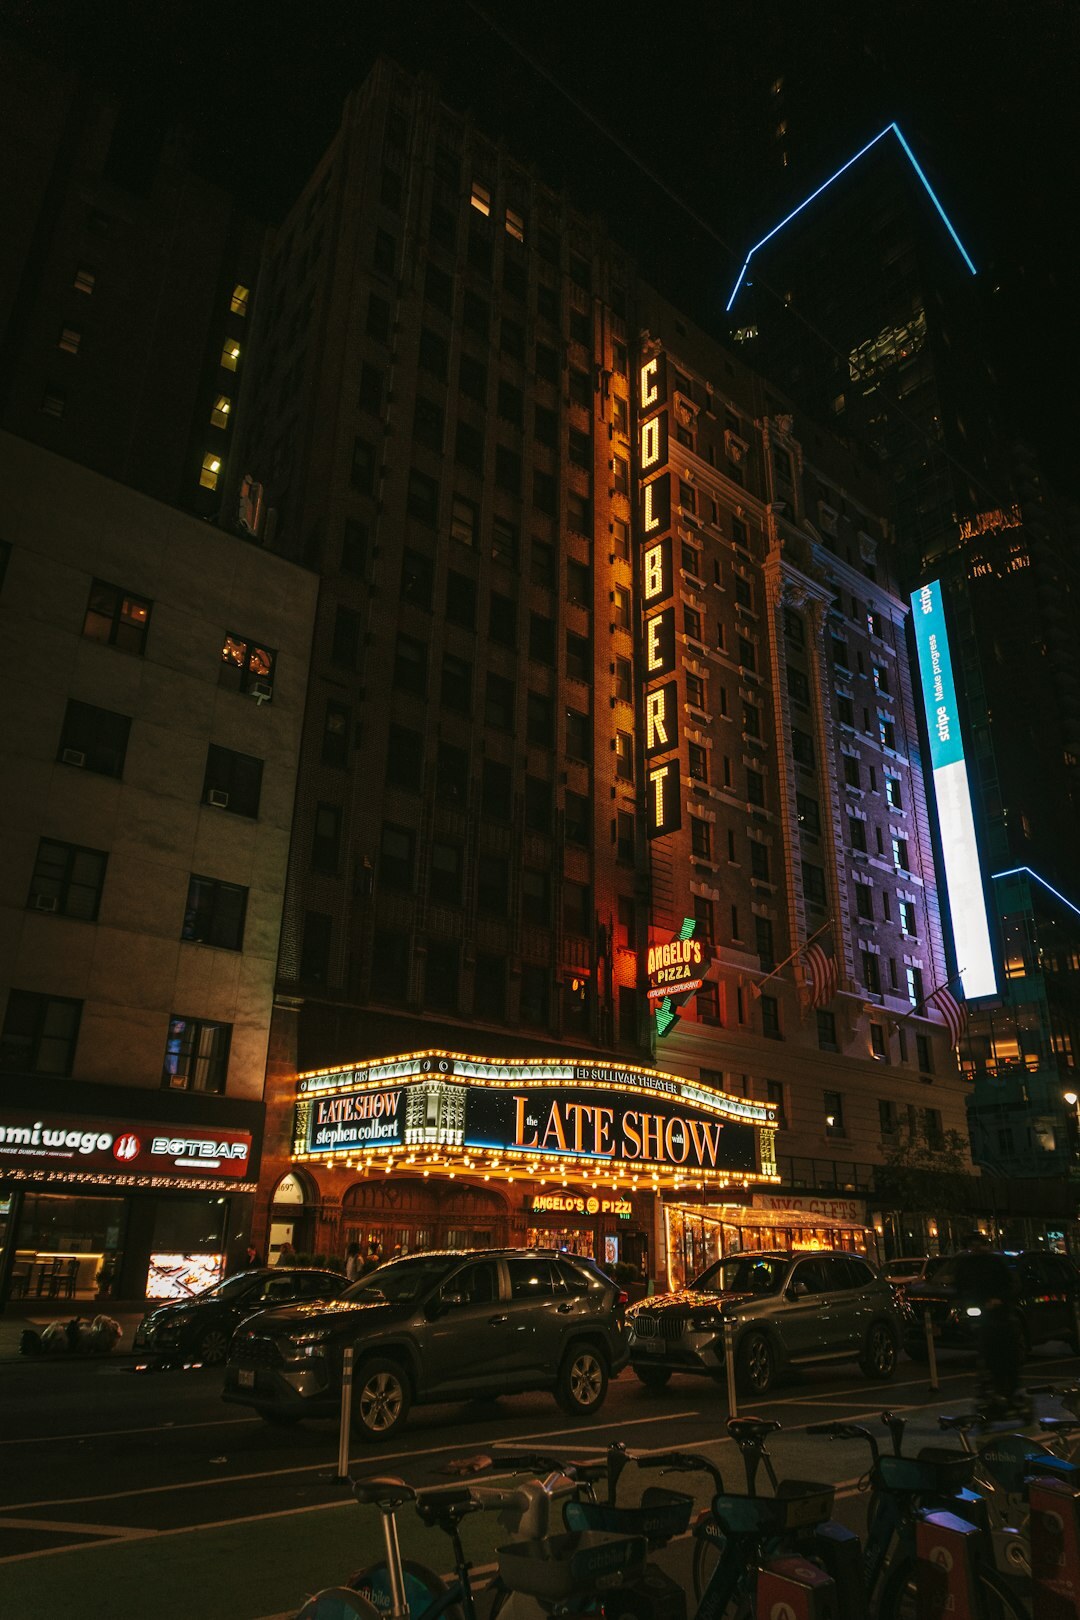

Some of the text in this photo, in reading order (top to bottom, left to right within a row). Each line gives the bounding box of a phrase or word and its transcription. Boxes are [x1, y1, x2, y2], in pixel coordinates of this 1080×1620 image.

[641, 358, 669, 828] COLBERT
[929, 634, 950, 742] stripe Make progress
[647, 939, 702, 975] ANGELO'S
[657, 964, 692, 983] PIZZA
[354, 1070, 369, 1083] CBS
[576, 1067, 678, 1094] ED SULLIVAN THEATER
[317, 1091, 402, 1125] LATE SHOW
[512, 1095, 724, 1167] LATE SHOW
[526, 1115, 538, 1127] the
[316, 1118, 399, 1151] stephen colbert
[671, 1134, 684, 1144] with
[151, 1136, 249, 1160] BOTBAR
[532, 1195, 585, 1211] ANGELO'S
[770, 1198, 857, 1220] NYC GIFTS
